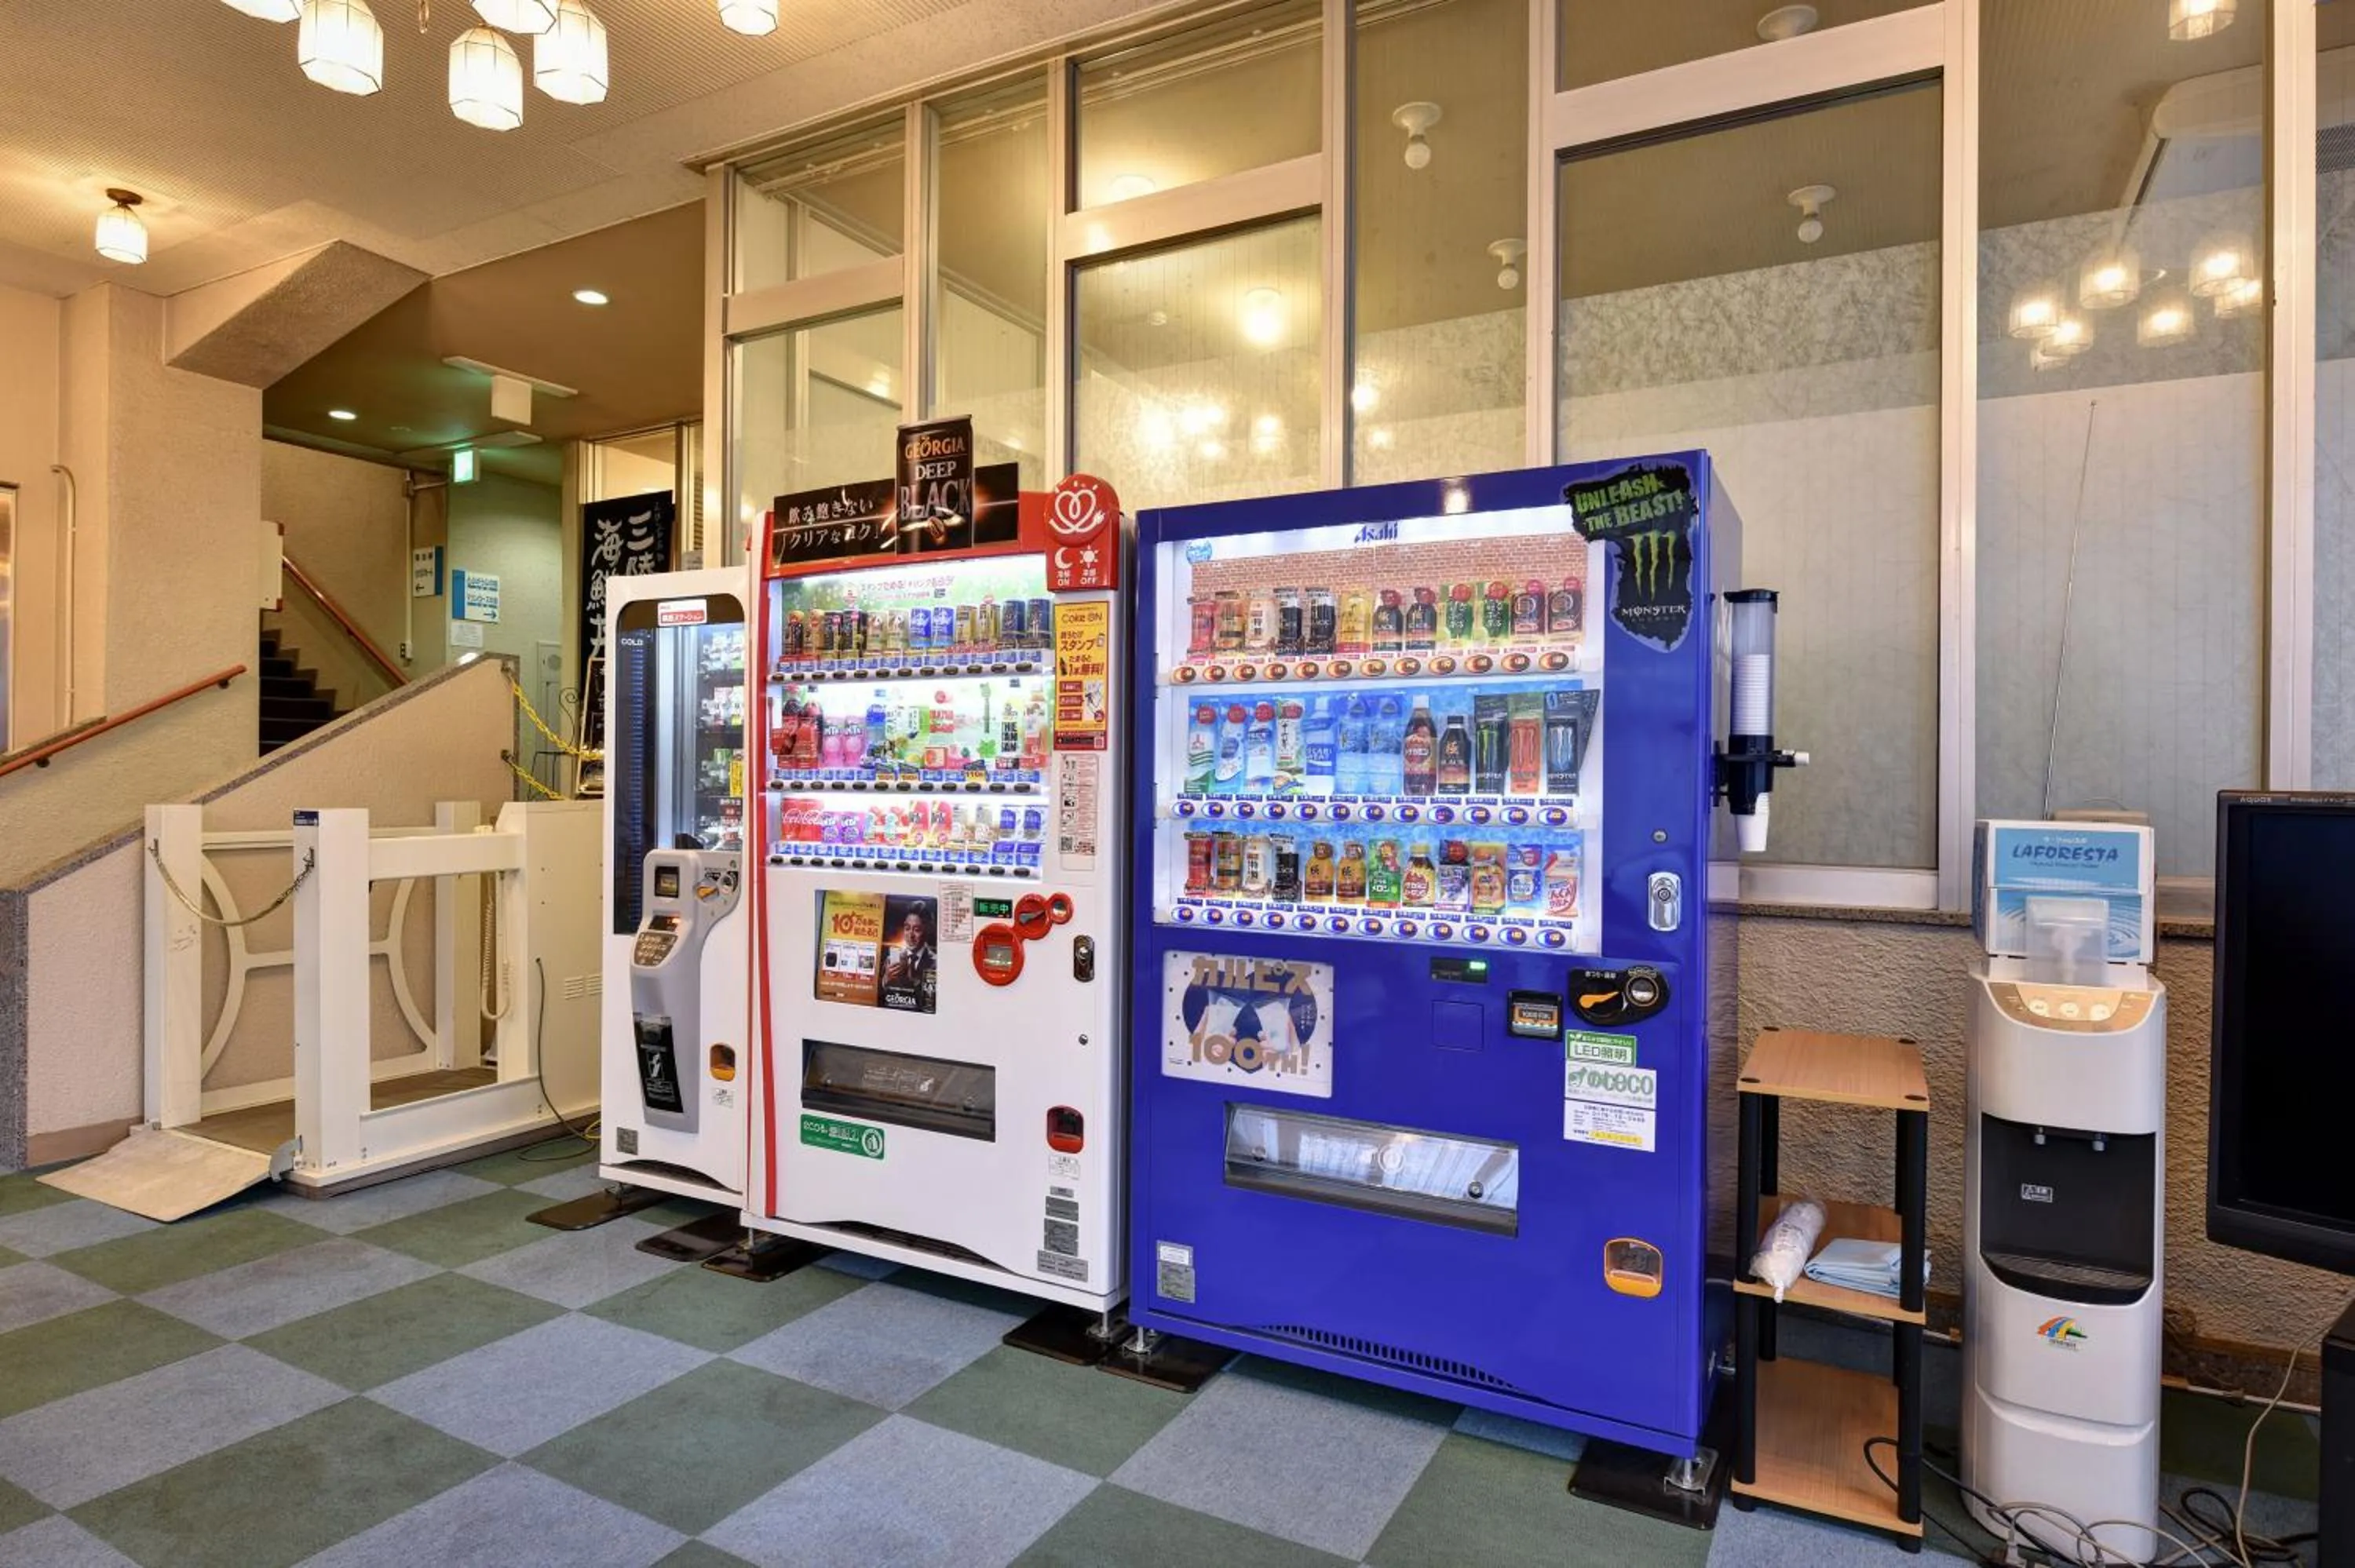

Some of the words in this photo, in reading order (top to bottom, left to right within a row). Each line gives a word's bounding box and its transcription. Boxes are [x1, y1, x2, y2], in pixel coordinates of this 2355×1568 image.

[904, 435, 966, 460] GEORGIA
[914, 461, 958, 481] DEEP
[899, 477, 972, 521] BLACK
[1575, 472, 1660, 513] UNLEASH
[788, 498, 874, 524] 飲み飽きない
[1584, 512, 1613, 532] THE
[1614, 489, 1685, 527] BEAST!
[1354, 522, 1399, 543] Asahi
[1622, 604, 1687, 617] MONSTER
[1061, 636, 1095, 653] スタンプ
[2012, 843, 2120, 862] LAFORESTA
[1191, 954, 1313, 996] カルピス
[1573, 1042, 1629, 1061] LED照明
